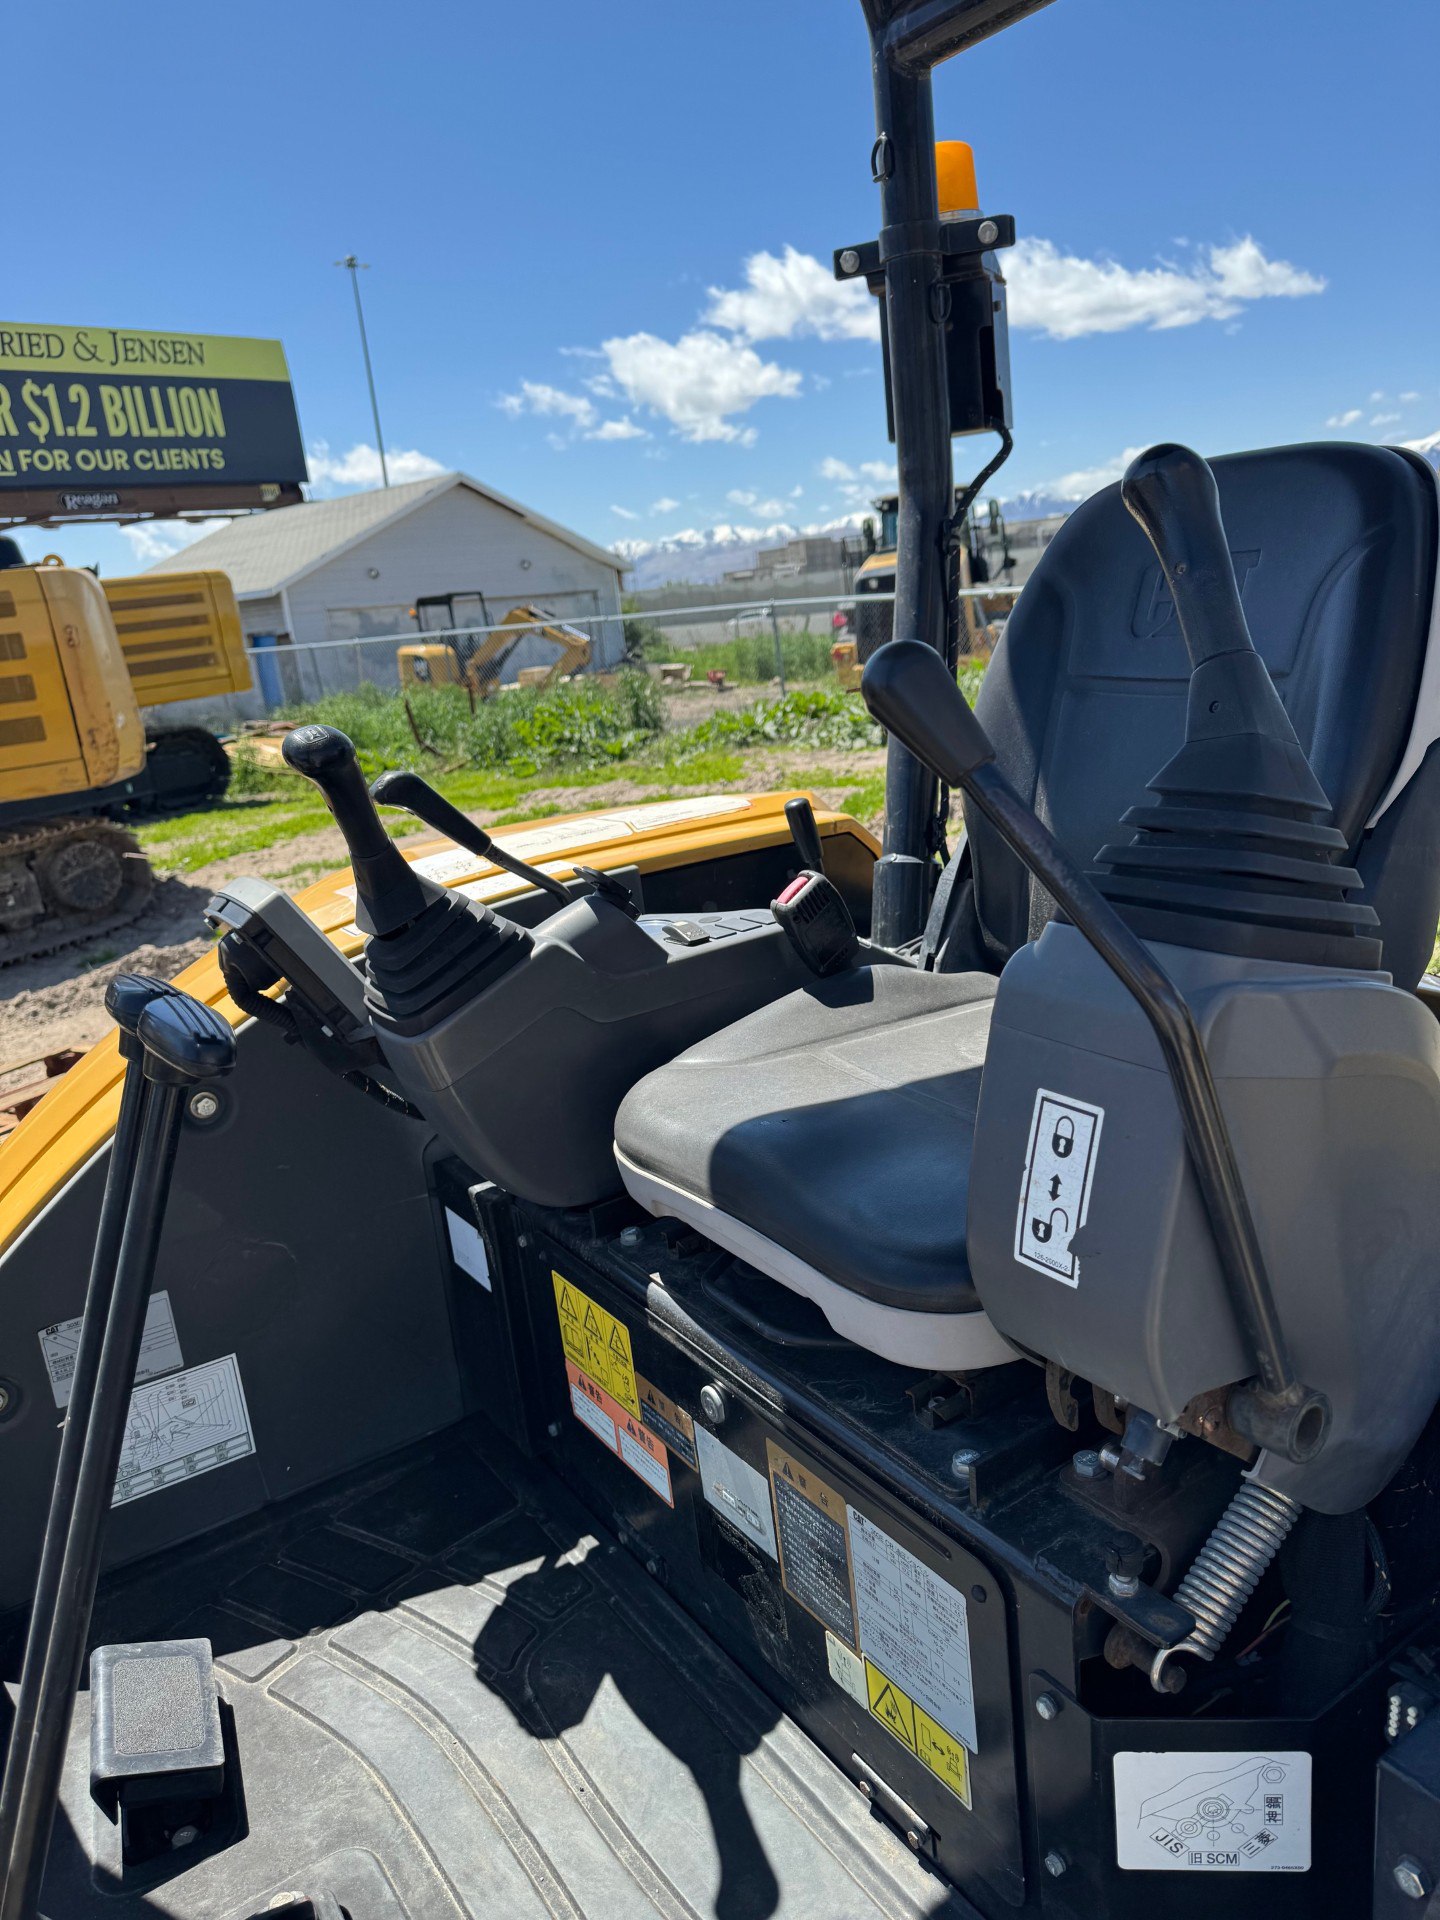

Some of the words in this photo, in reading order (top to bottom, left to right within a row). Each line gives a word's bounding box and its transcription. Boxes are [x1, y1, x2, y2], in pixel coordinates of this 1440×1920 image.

[73, 331, 104, 362] &
[109, 330, 206, 366] JENSEN
[21, 378, 98, 443] $1.2
[99, 384, 227, 438] BILLION
[18, 448, 71, 472] FOR
[75, 449, 130, 472] OUR
[133, 448, 226, 471] CLIENTS
[45, 1325, 59, 1335] CAT
[1156, 1833, 1184, 1855] JIS
[1206, 1852, 1238, 1864] SCM
